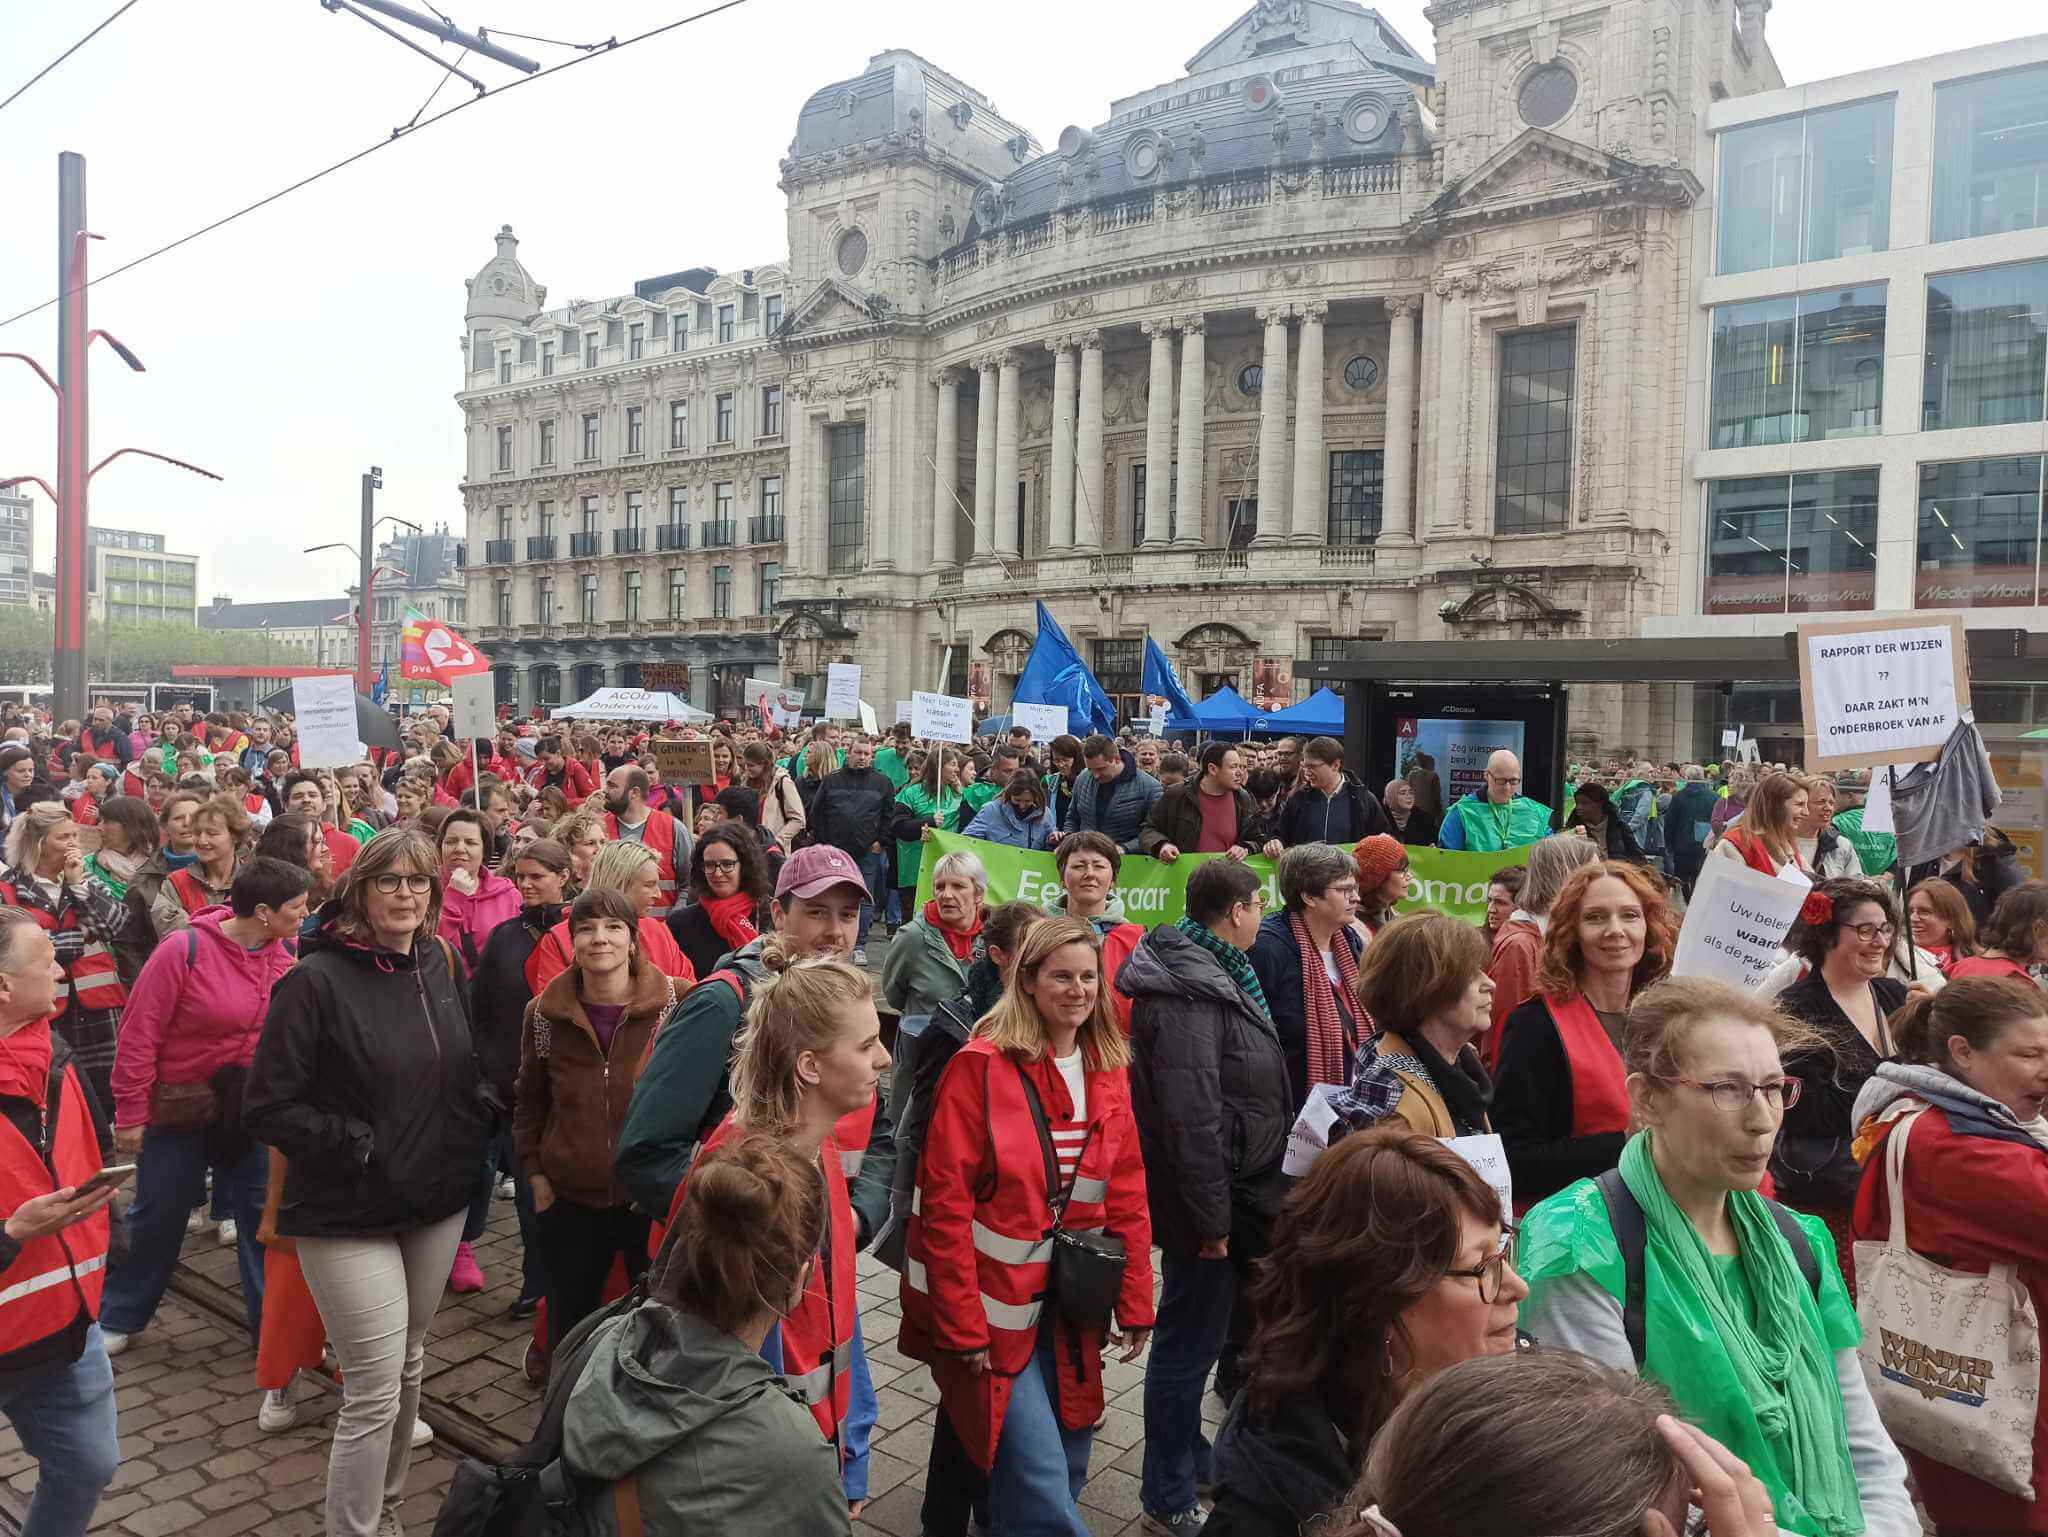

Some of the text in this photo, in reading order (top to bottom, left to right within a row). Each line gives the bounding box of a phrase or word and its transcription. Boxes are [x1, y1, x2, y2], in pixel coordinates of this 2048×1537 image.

[1821, 639, 1943, 659] RAPPORT DER WIJZEN
[1878, 671, 1889, 680] ??
[609, 691, 652, 700] ACOD
[590, 701, 659, 711] Onderwijs
[1441, 705, 1476, 713] JCDecaux
[1845, 696, 1929, 713] DAAR ZAKT M'N
[1401, 721, 1412, 733] A
[1829, 715, 1946, 736] ONDERBROEK VAN AF
[1451, 744, 1466, 753] Zeg
[1730, 900, 1753, 919] Uw
[1703, 935, 1722, 950] als
[1725, 943, 1742, 958] de
[1880, 1327, 1995, 1379] WONDER
[1881, 1345, 1986, 1398] WOMAN
